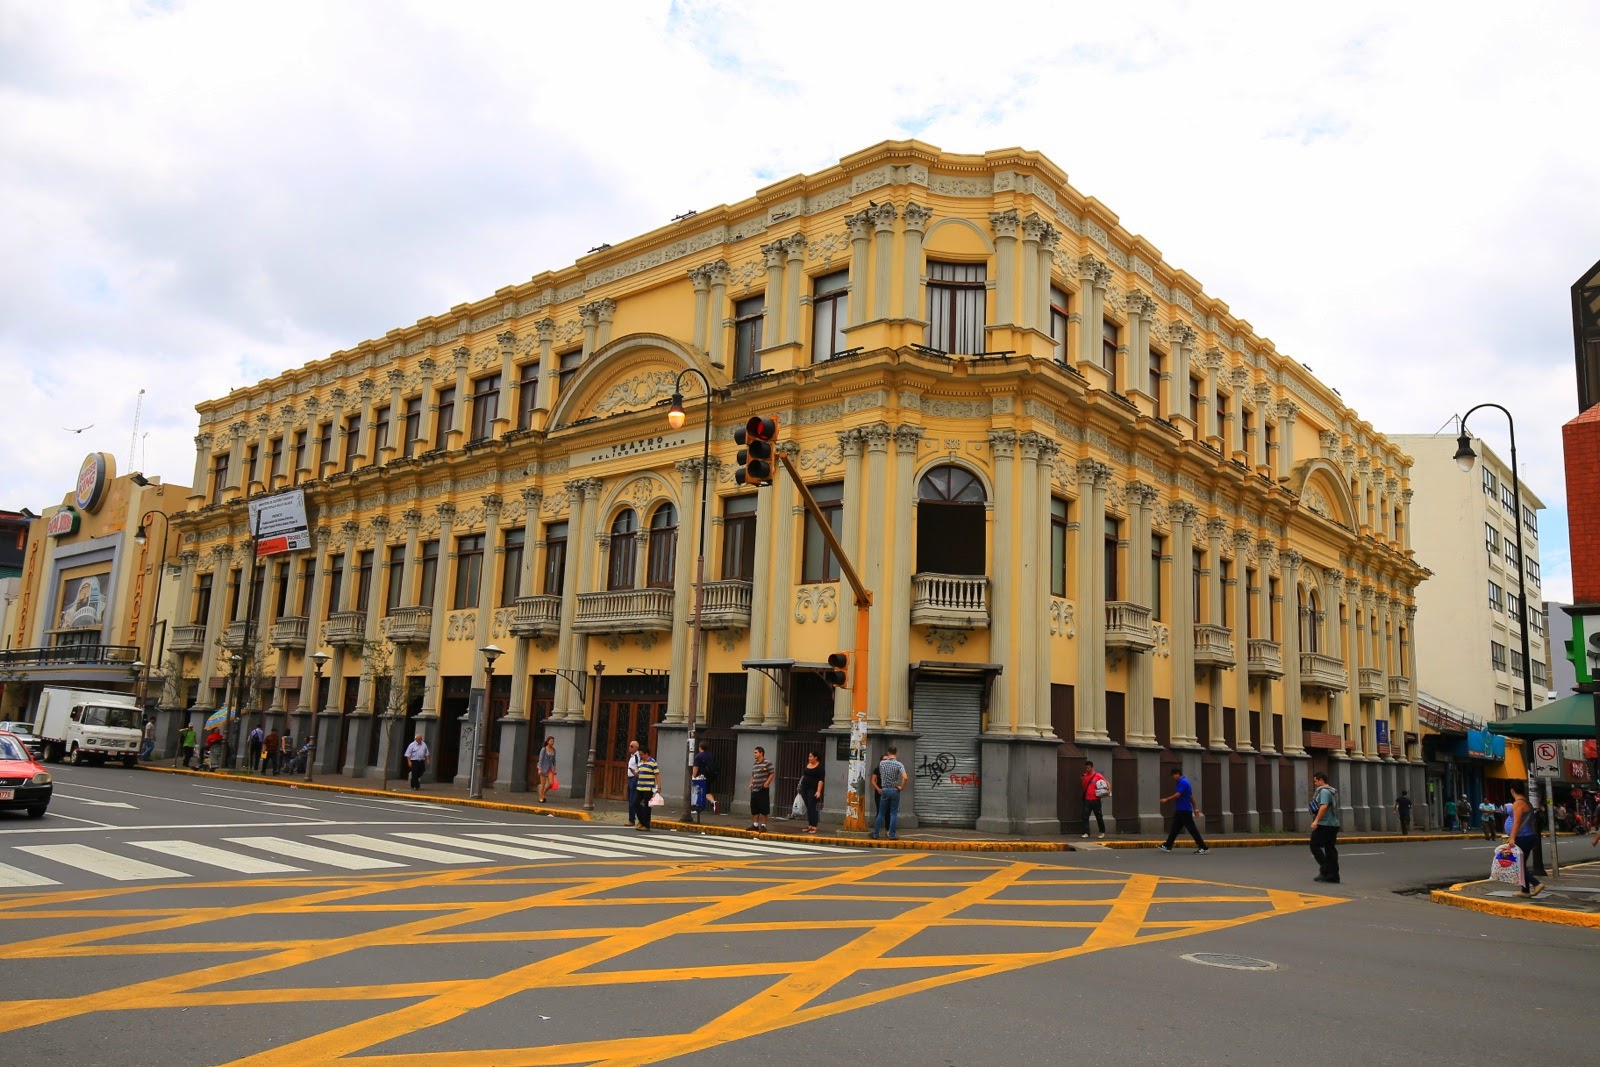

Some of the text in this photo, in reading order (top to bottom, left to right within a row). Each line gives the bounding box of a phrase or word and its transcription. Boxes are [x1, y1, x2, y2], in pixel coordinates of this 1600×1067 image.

[612, 436, 663, 452] TEATRO
[634, 439, 685, 453] SALAZAR
[79, 471, 96, 495] KING
[17, 540, 39, 648] PALACE
